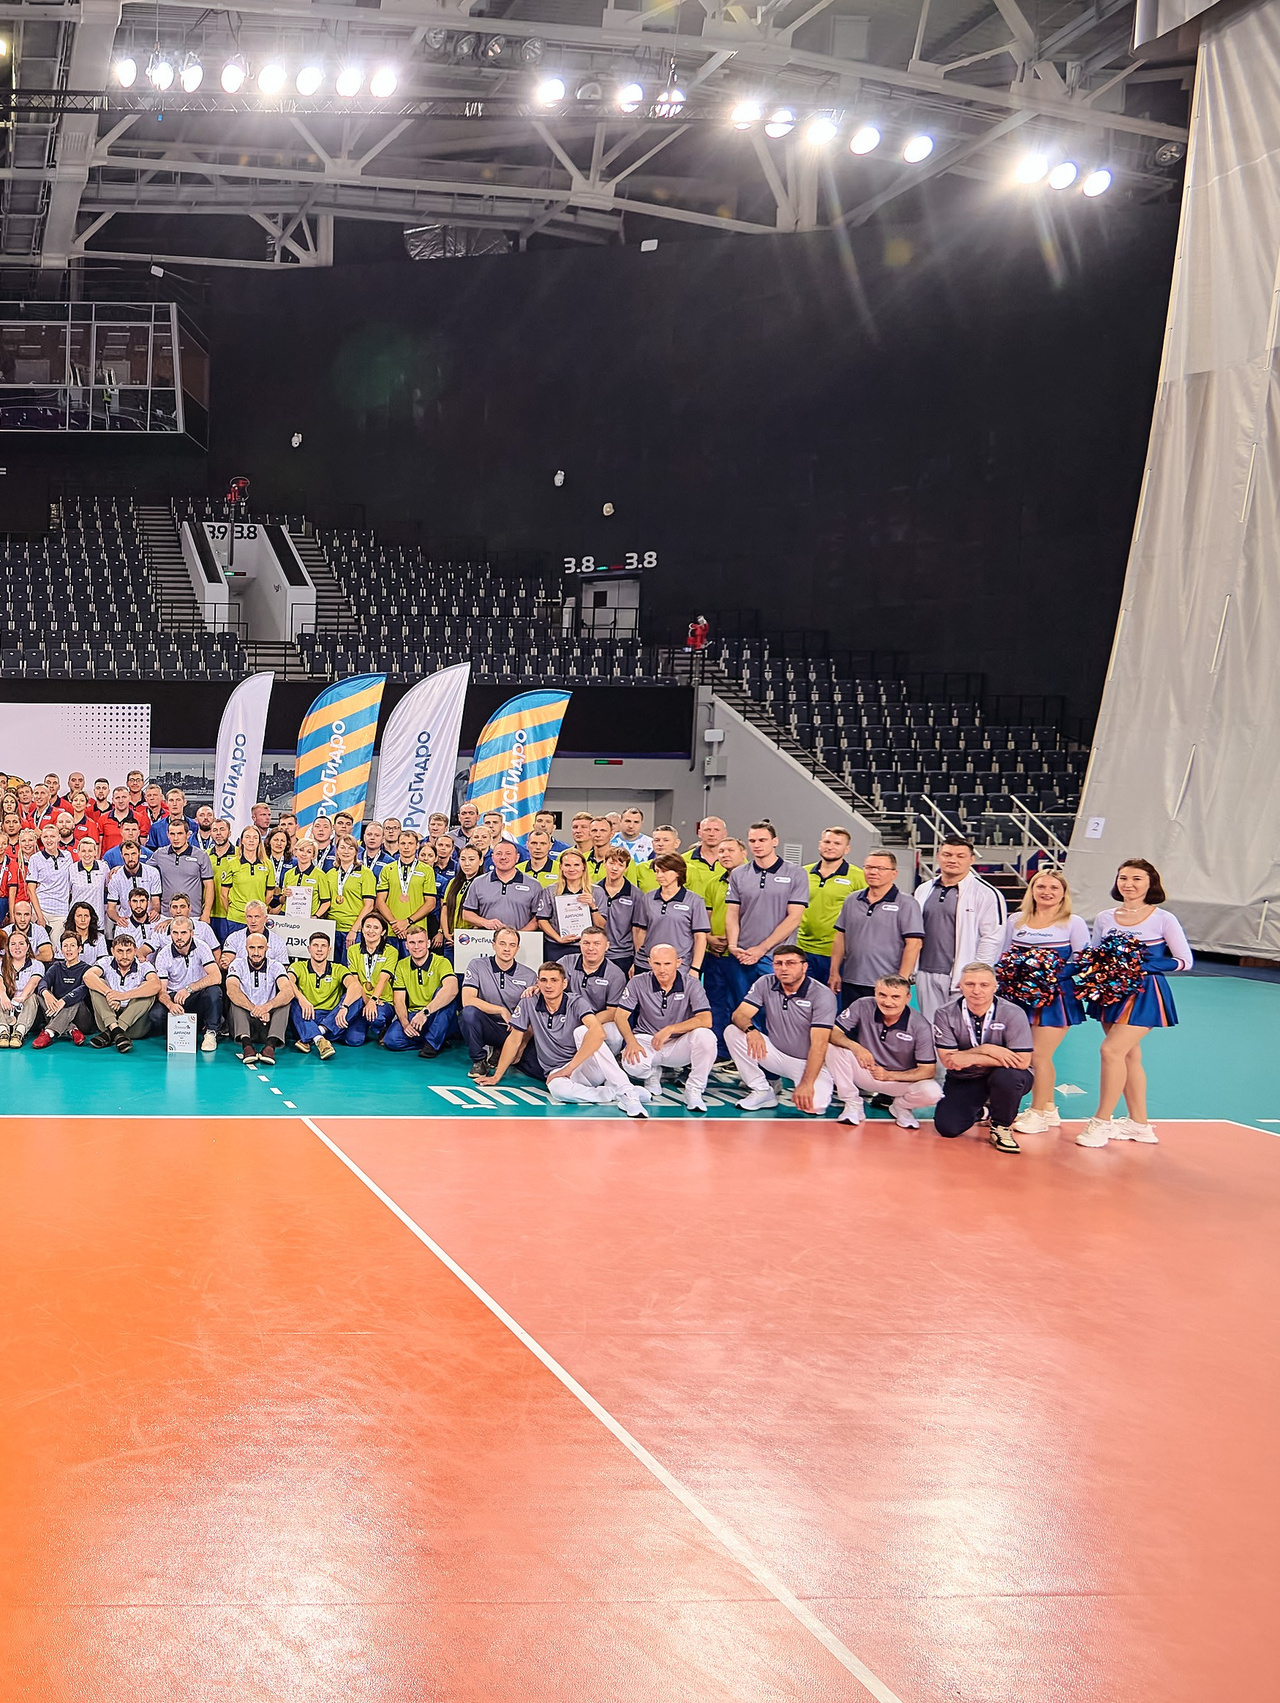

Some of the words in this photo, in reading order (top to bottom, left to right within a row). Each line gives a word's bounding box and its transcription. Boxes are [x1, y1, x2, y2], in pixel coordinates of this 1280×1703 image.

[207, 525, 228, 540] 3.9
[234, 525, 258, 540] 3.8
[563, 555, 595, 574] 3.8
[625, 551, 658, 570] 3.8
[220, 733, 247, 821] усГидро
[403, 731, 431, 827] РусГидро
[1091, 821, 1100, 831] 2
[275, 921, 301, 929] РусГидро
[286, 937, 308, 947] ДЭК
[471, 936, 494, 944] РусГид
